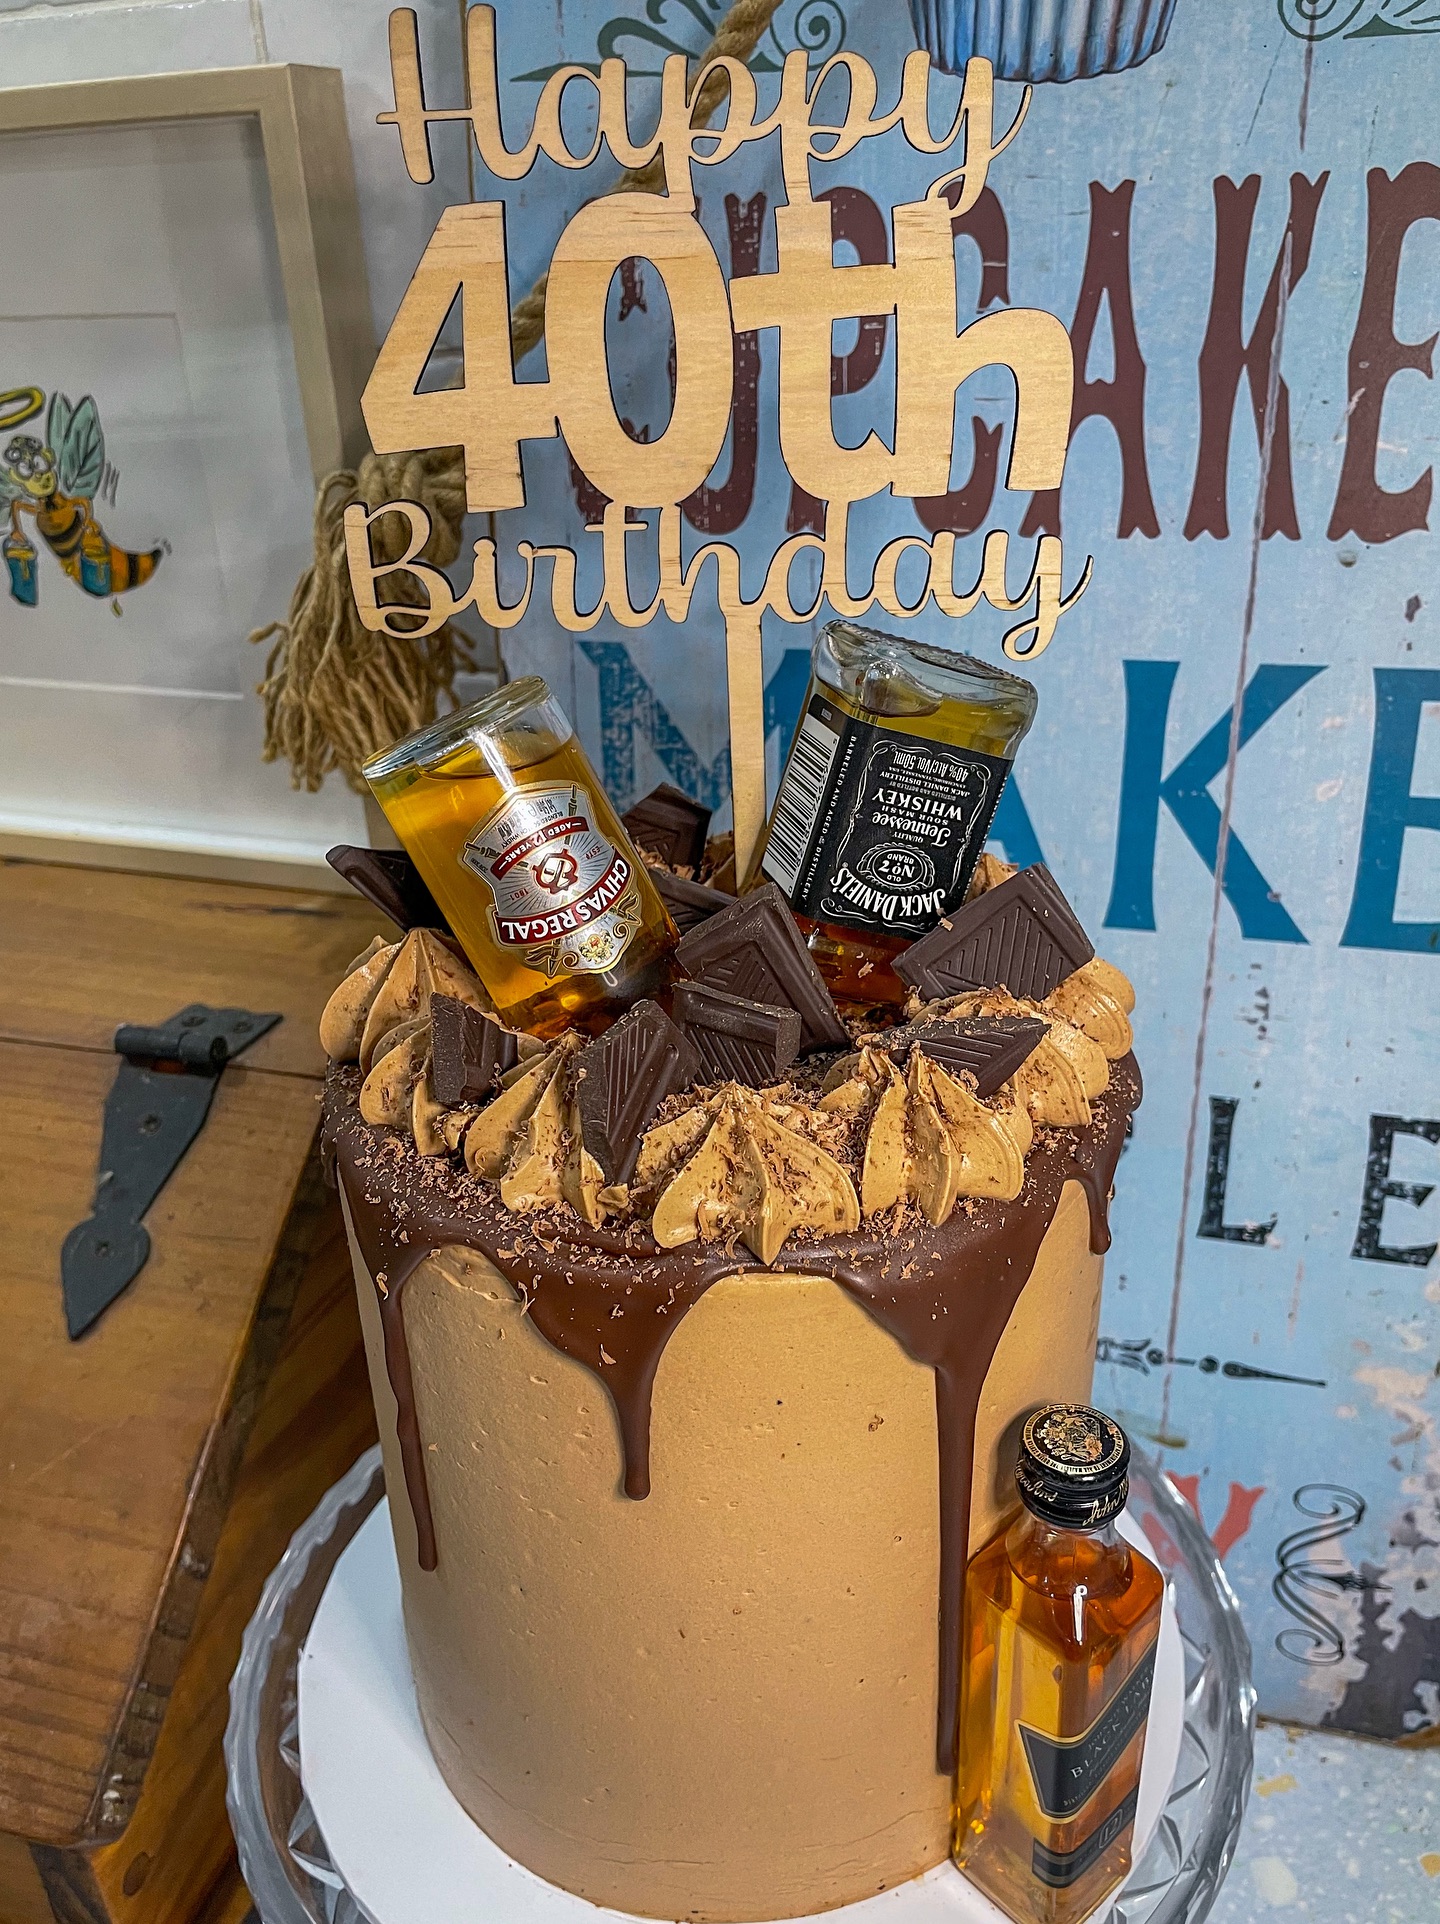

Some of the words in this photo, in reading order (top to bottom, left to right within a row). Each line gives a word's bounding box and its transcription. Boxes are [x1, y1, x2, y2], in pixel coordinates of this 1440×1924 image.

[376, 4, 1033, 219] Happy
[359, 191, 1075, 514] 40th
[569, 164, 1440, 545] UPCAKE
[343, 497, 1094, 661] Birthday
[838, 735, 857, 786] BARRELED
[878, 770, 922, 786] DISTILLERY
[948, 764, 969, 783] 40%
[577, 640, 1440, 952] MKE
[833, 787, 841, 807] AND
[922, 780, 949, 793] DANIEL
[949, 787, 970, 797] JACK
[871, 787, 961, 821] WHISKEY
[880, 804, 915, 818] MASH
[547, 821, 571, 836] AGED
[822, 810, 833, 834] AGED
[871, 811, 951, 847] Tennessee
[918, 813, 949, 825] SOUR
[531, 829, 547, 846] 12
[891, 830, 924, 843] QUALITY
[504, 841, 532, 860] YEARS
[886, 852, 914, 864] BRAND
[802, 847, 821, 900] DISTILLERY
[885, 873, 902, 882] OLD
[576, 859, 628, 921] CHIVAS
[894, 887, 946, 916] JACK
[501, 912, 579, 940] REGAL
[1070, 1721, 1121, 1779] BLACK
